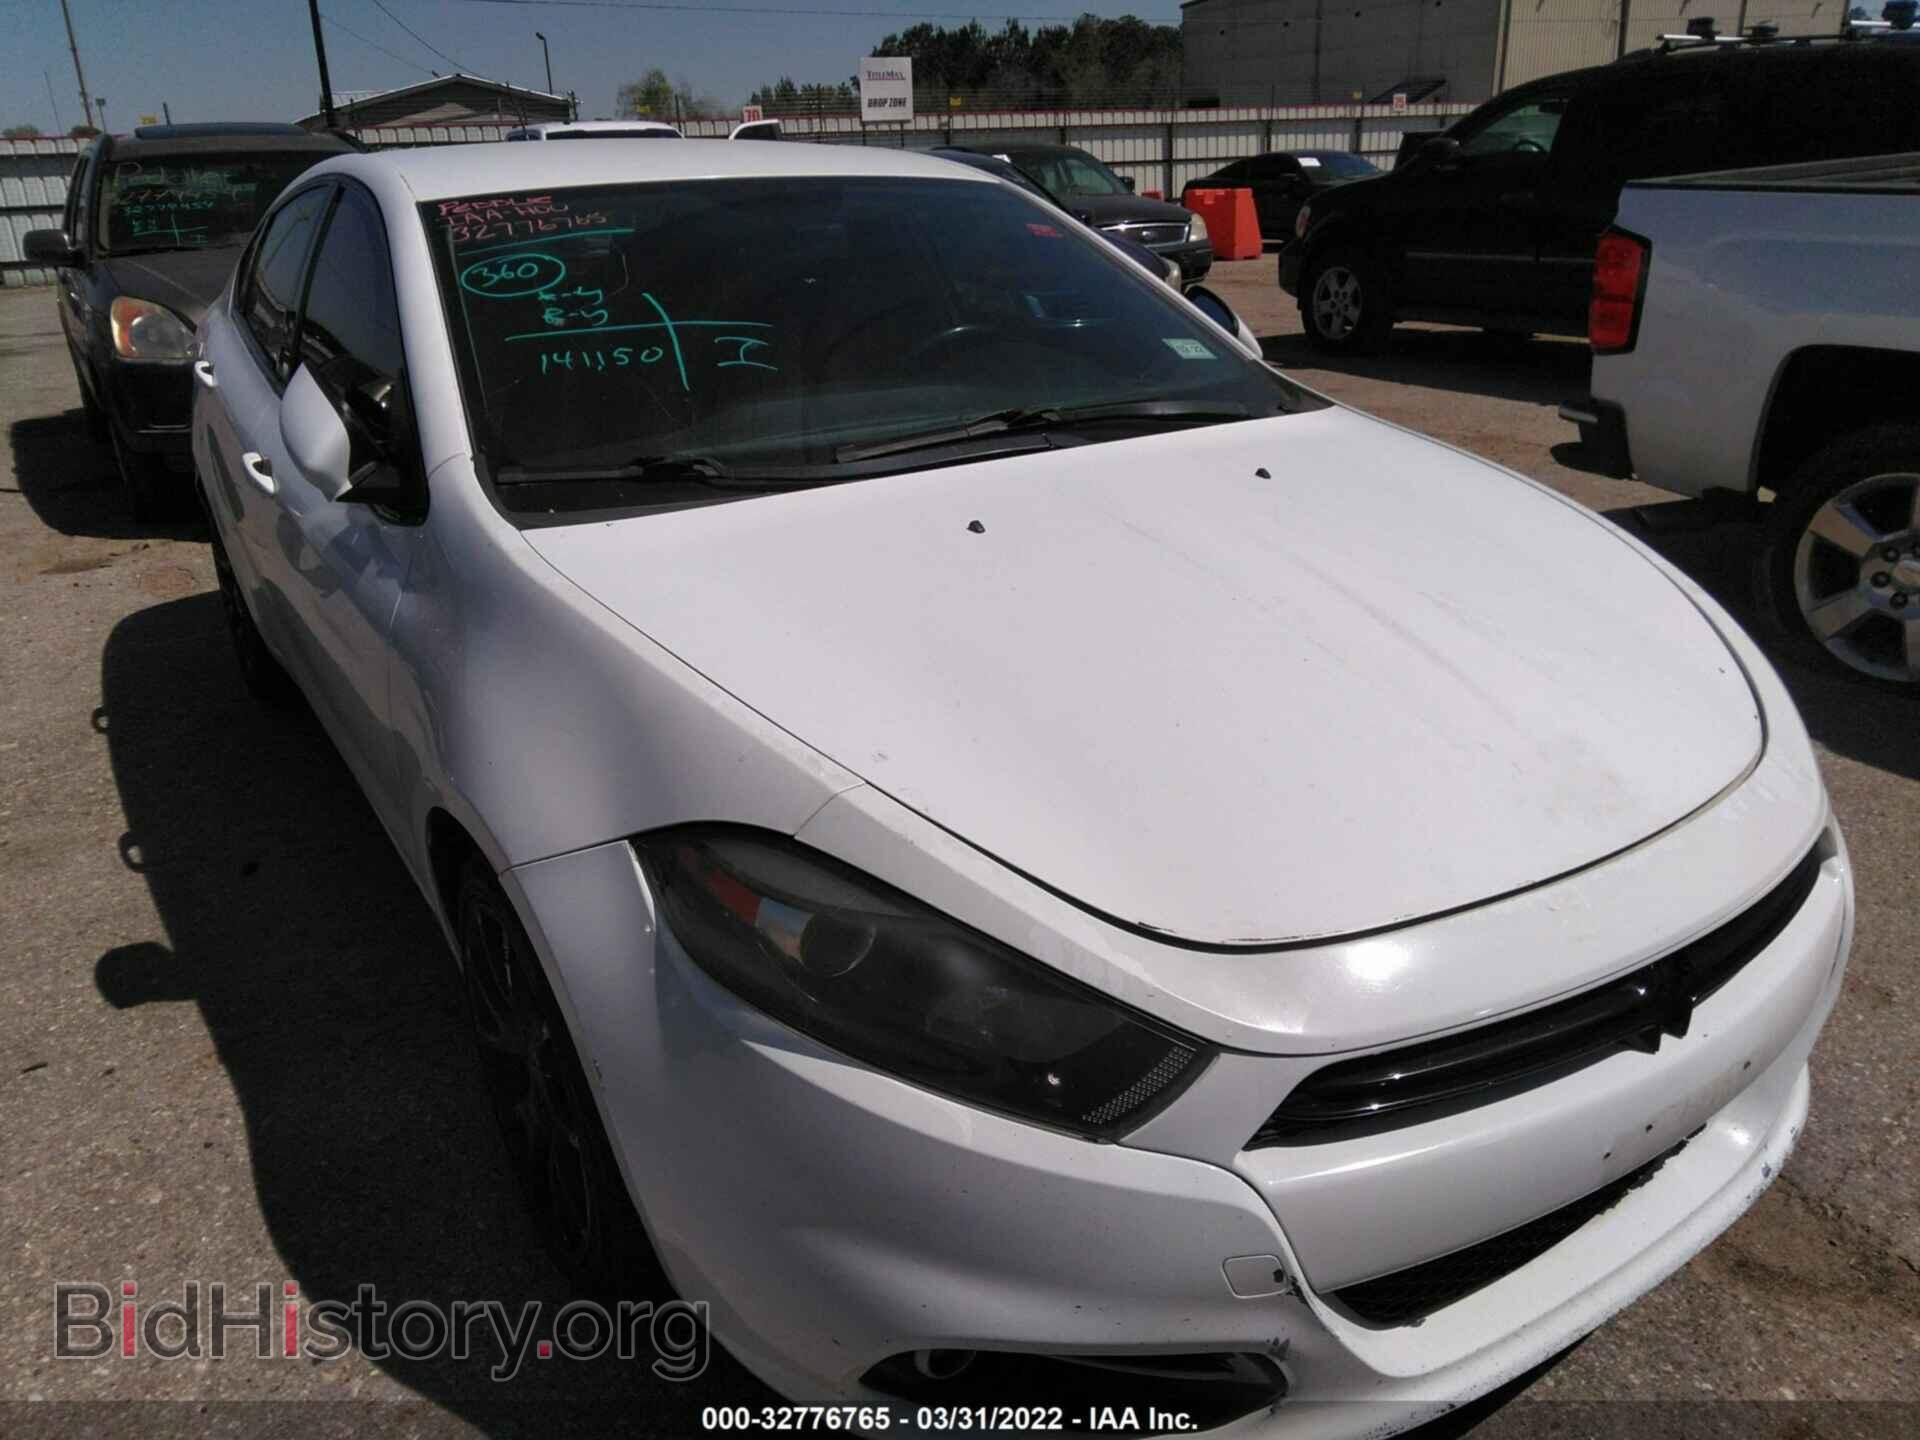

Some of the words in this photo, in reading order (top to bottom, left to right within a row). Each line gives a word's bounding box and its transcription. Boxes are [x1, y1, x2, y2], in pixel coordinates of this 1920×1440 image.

[867, 97, 888, 108] DROP
[888, 97, 907, 108] ZONE
[472, 262, 539, 288] 360
